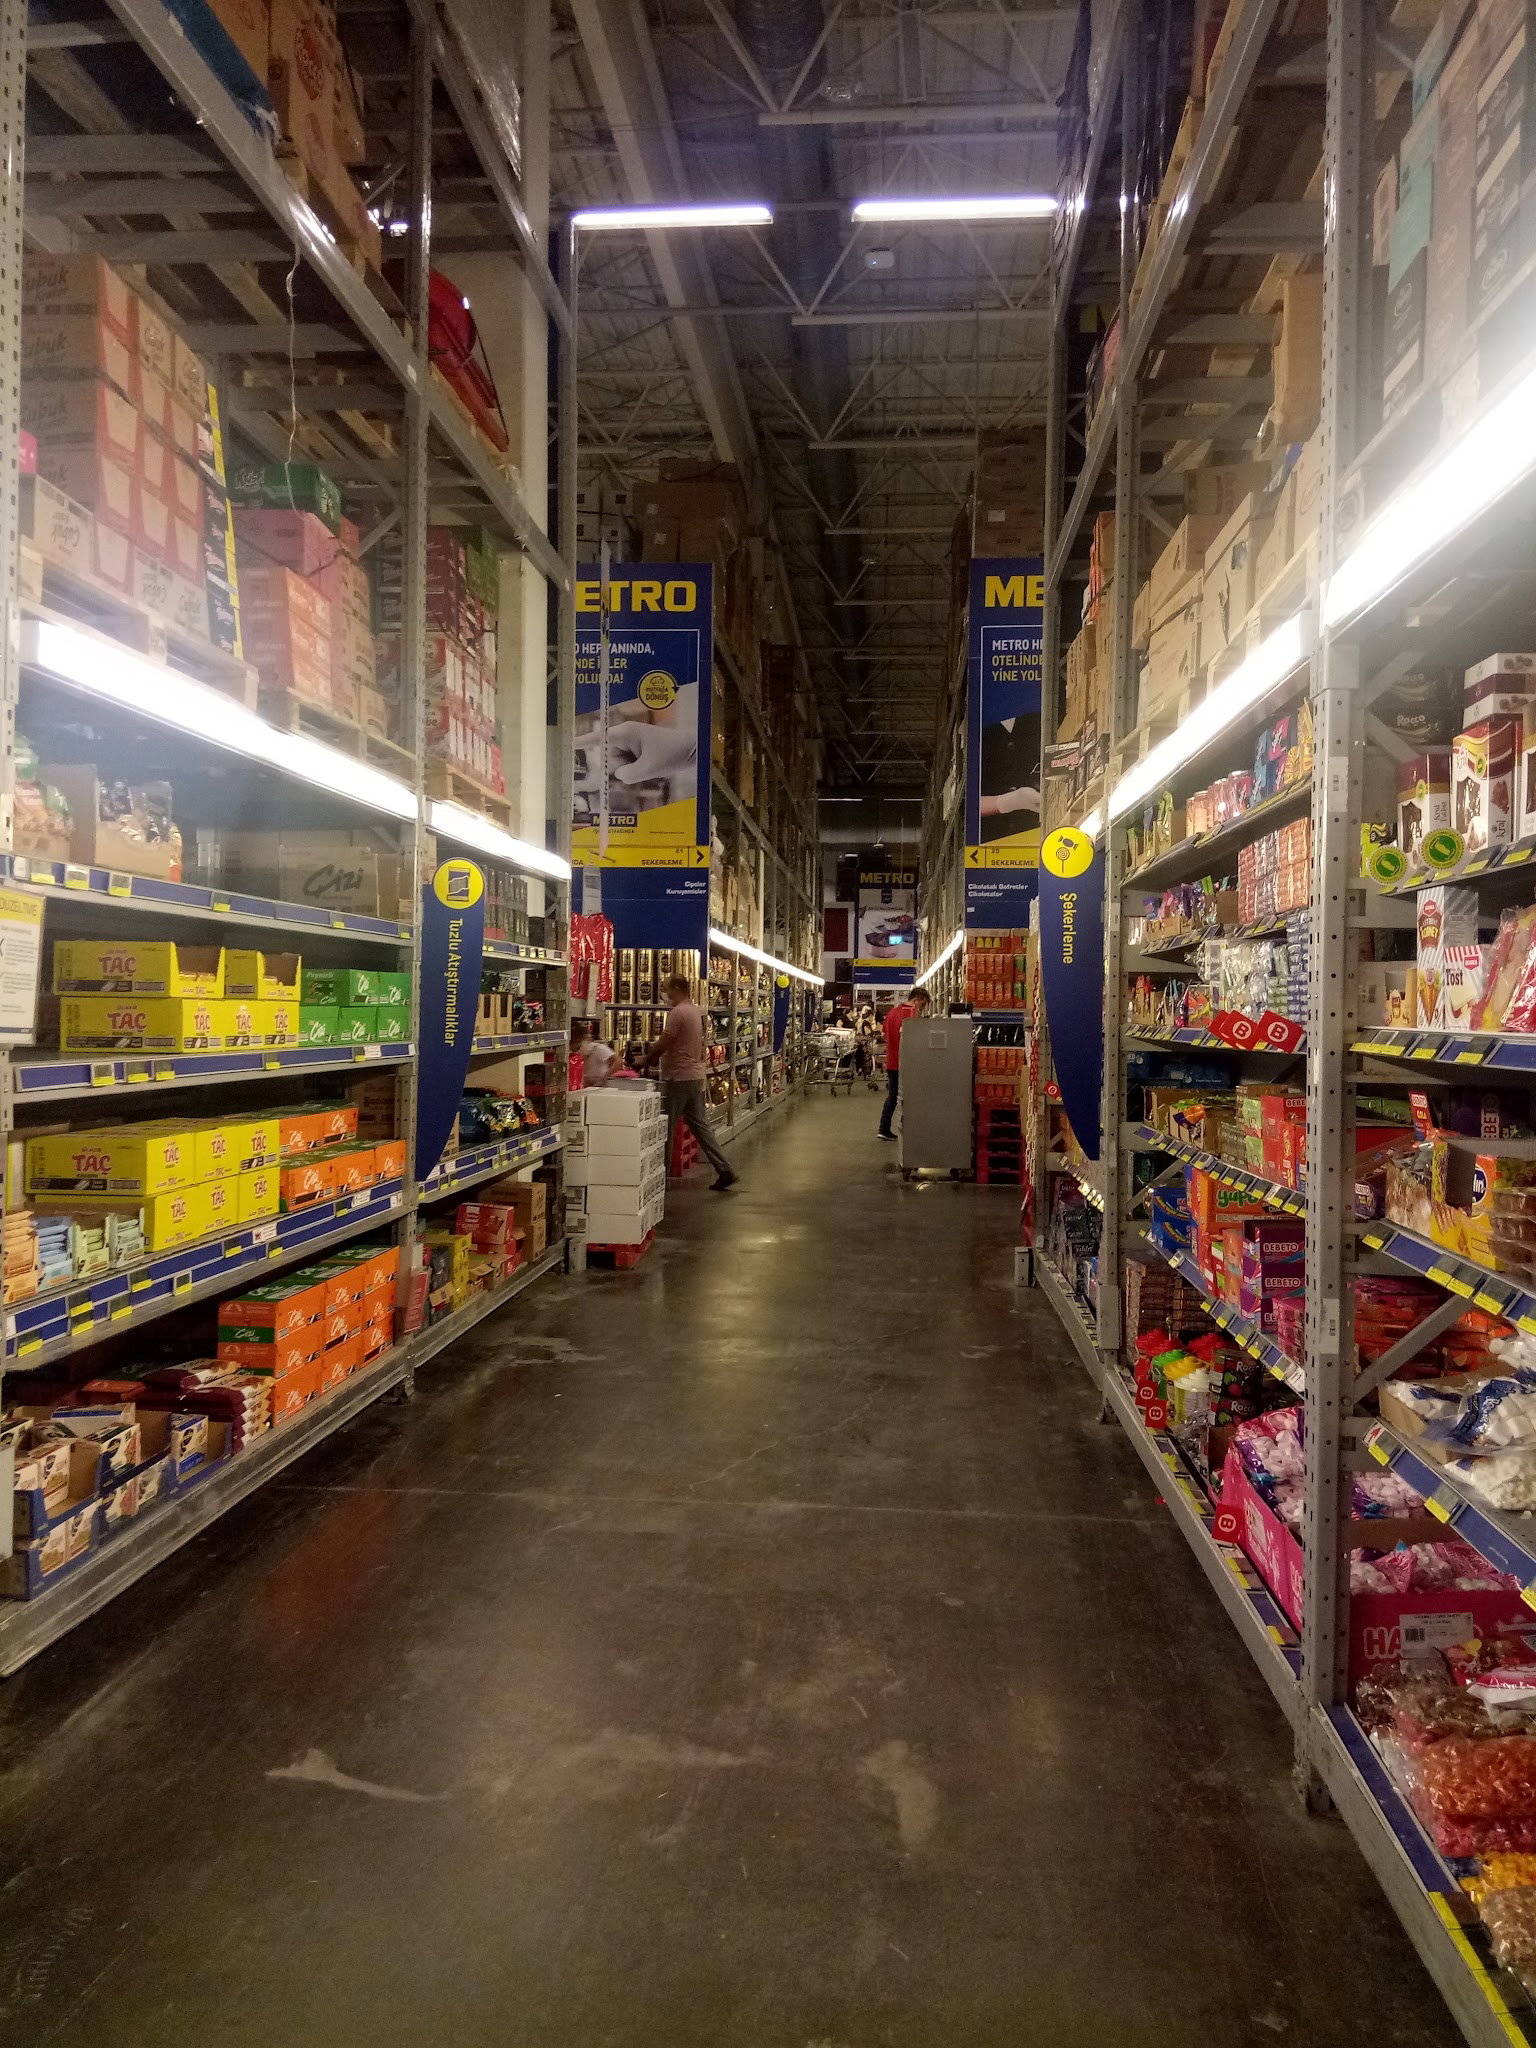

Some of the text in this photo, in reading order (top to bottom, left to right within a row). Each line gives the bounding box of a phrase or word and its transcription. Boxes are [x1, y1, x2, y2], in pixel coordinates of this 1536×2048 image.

[992, 639, 1029, 651] METRO
[991, 668, 1018, 681] YİNE
[646, 693, 669, 703] DÖNÜŞ
[1396, 714, 1426, 728] Rocco
[592, 815, 636, 825] MTRO
[1496, 820, 1507, 838] Kral
[860, 872, 915, 884] METRO
[1059, 892, 1078, 964] Şekerleme
[98, 956, 137, 977] TAÇ
[443, 918, 464, 1047] Tuzlu Atıştırmalıklar
[1445, 968, 1464, 986] Tost
[107, 1012, 148, 1033] TAÇ
[71, 1154, 113, 1175] TAÇ
[1263, 1242, 1299, 1252] BEBETO
[1265, 1277, 1300, 1288] BEBETO
